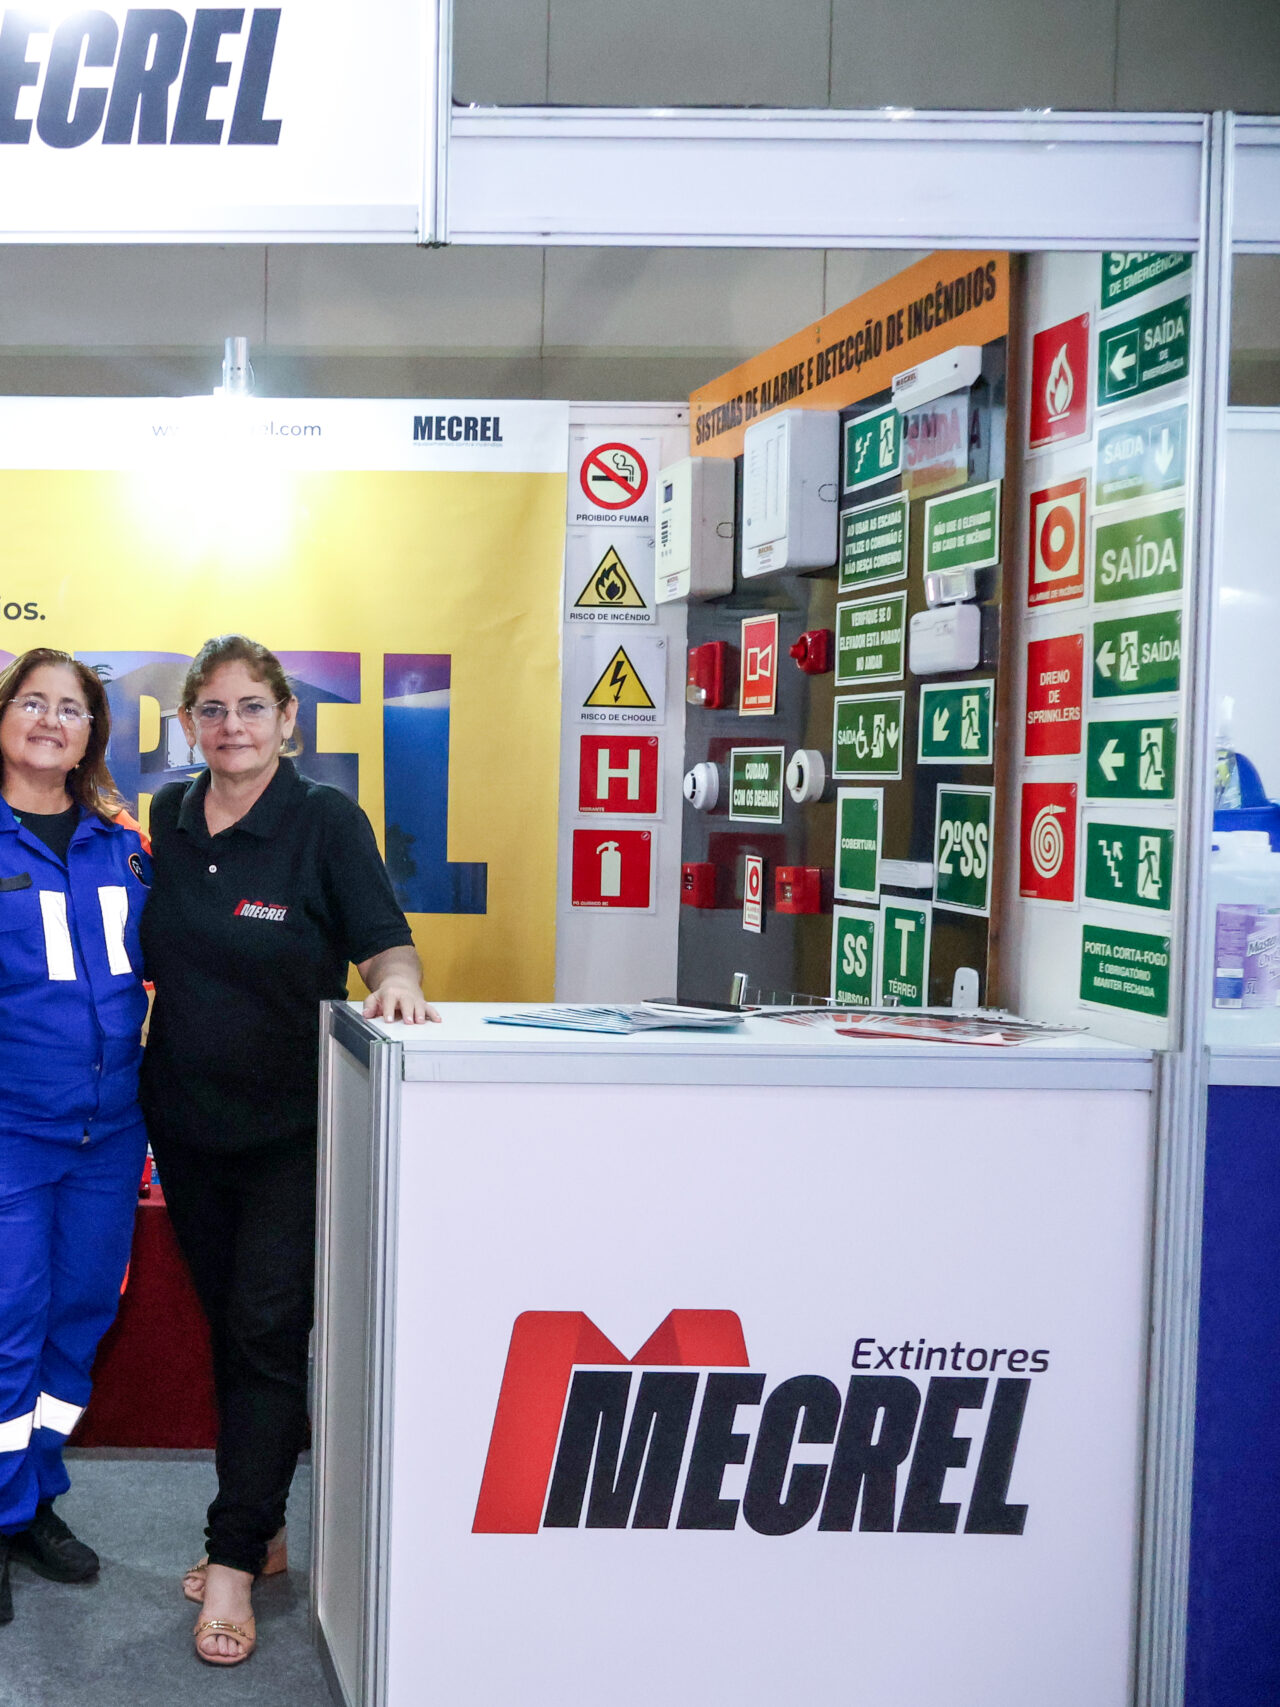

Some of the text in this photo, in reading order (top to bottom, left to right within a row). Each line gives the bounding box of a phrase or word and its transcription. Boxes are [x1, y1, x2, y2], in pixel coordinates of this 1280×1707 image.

[1109, 280, 1122, 297] DE
[1123, 252, 1184, 291] EMERGÊNCIA
[1144, 316, 1185, 351] SAÍDA
[696, 260, 997, 446] SISTEMAS DE ALARME E DETECÇÃO DE INCÊNDIOS
[1159, 349, 1168, 361] DE
[413, 416, 503, 441] MECREL
[576, 514, 649, 523] PROIBIDO FUMAR
[878, 510, 902, 530] ESCADAS
[845, 560, 856, 575] NÃO
[1101, 535, 1177, 586] SAÍDA
[570, 612, 651, 622] RISCO DE INCÊNDIO
[840, 633, 866, 650] ELEVADOR
[880, 628, 901, 645] PARADO
[1141, 635, 1181, 663] SAÍDA
[865, 654, 883, 670] ANDAR
[1040, 669, 1070, 686] DRENO
[1048, 690, 1060, 703] DE
[581, 713, 657, 722] RISCO DE CHOQUE
[1027, 706, 1081, 724] SPRINKLERS
[837, 726, 857, 746] SAÍDA
[596, 748, 641, 800] H
[745, 763, 769, 780] CUIDADO
[734, 789, 779, 808] COM OS DEGRAUS
[841, 838, 876, 851] COBERTURA
[938, 820, 988, 879] 2ºSS
[239, 903, 287, 921] MECREL
[842, 933, 867, 978] SS
[894, 917, 916, 977] T
[1084, 940, 1168, 967] PORTA CORTA-FOGO
[1099, 961, 1151, 982] É OBRIGATÓRIO
[888, 977, 917, 999] TÉRREO
[1093, 976, 1155, 998] MANTER FECHADA
[851, 1337, 1050, 1374] Extintores
[543, 1371, 1032, 1536] MECREL
